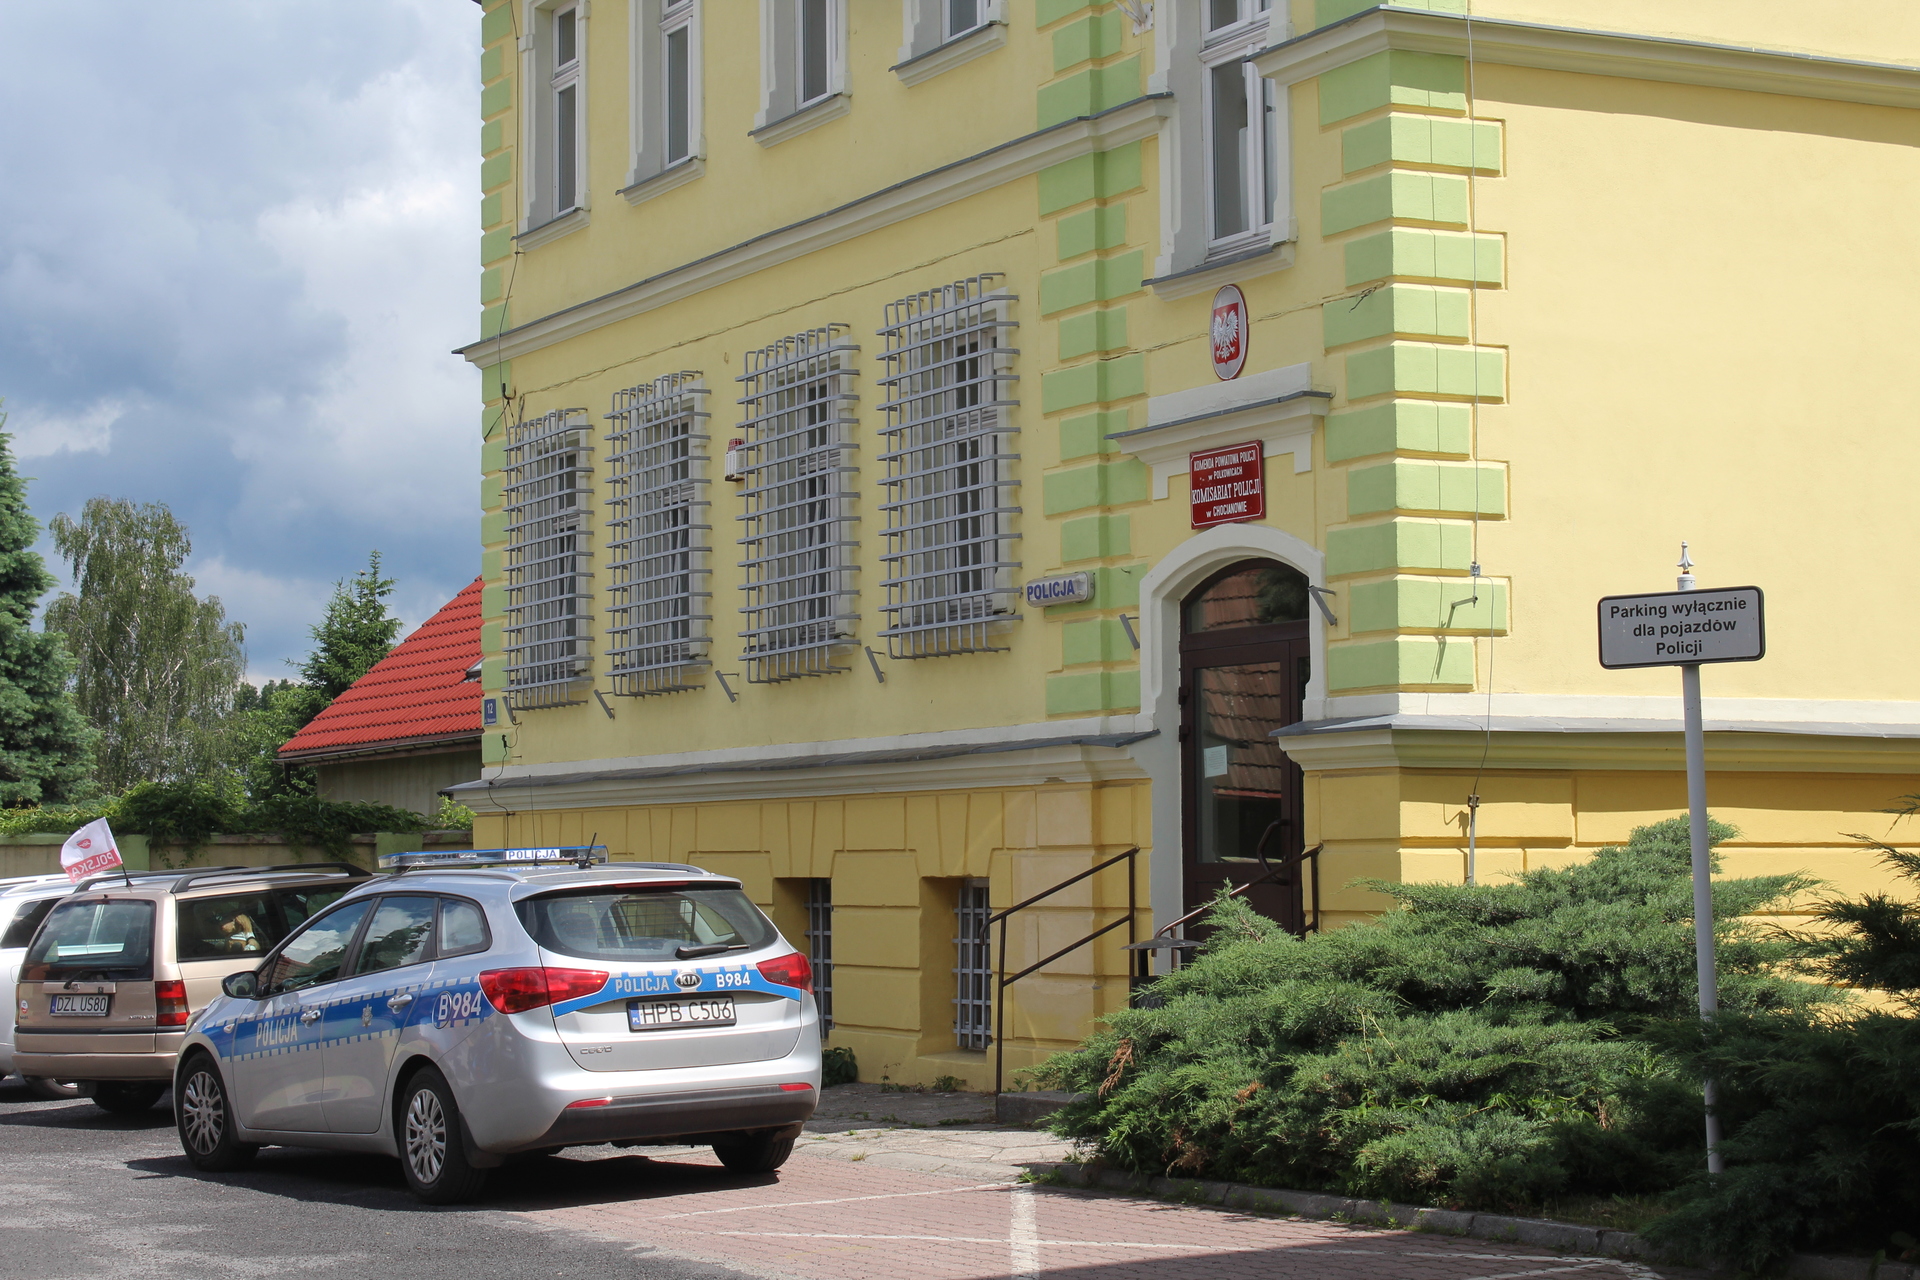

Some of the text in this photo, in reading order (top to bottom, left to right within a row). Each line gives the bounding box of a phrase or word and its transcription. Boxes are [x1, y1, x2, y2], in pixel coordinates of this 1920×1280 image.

[1194, 458, 1214, 471] KOMENDA
[1240, 450, 1256, 463] POLICJI
[1214, 466, 1243, 480] POLKOWICACH
[1192, 479, 1260, 504] KOMISARIAT POLICJI
[1213, 501, 1247, 517] CHOCIANOWIE
[1027, 580, 1075, 601] POLICJA
[1610, 597, 1747, 619] Parking wyłącznie
[1633, 619, 1737, 638] dla pojazdów
[1656, 640, 1702, 656] Policji
[508, 850, 557, 860] POLICJA
[615, 976, 670, 993] POLICJA
[679, 975, 698, 985] KIA
[716, 971, 751, 988] B984
[57, 996, 107, 1011] DZL US80
[642, 1002, 682, 1024] HPB
[688, 1000, 732, 1020] C506
[255, 1015, 298, 1048] POLICJA
